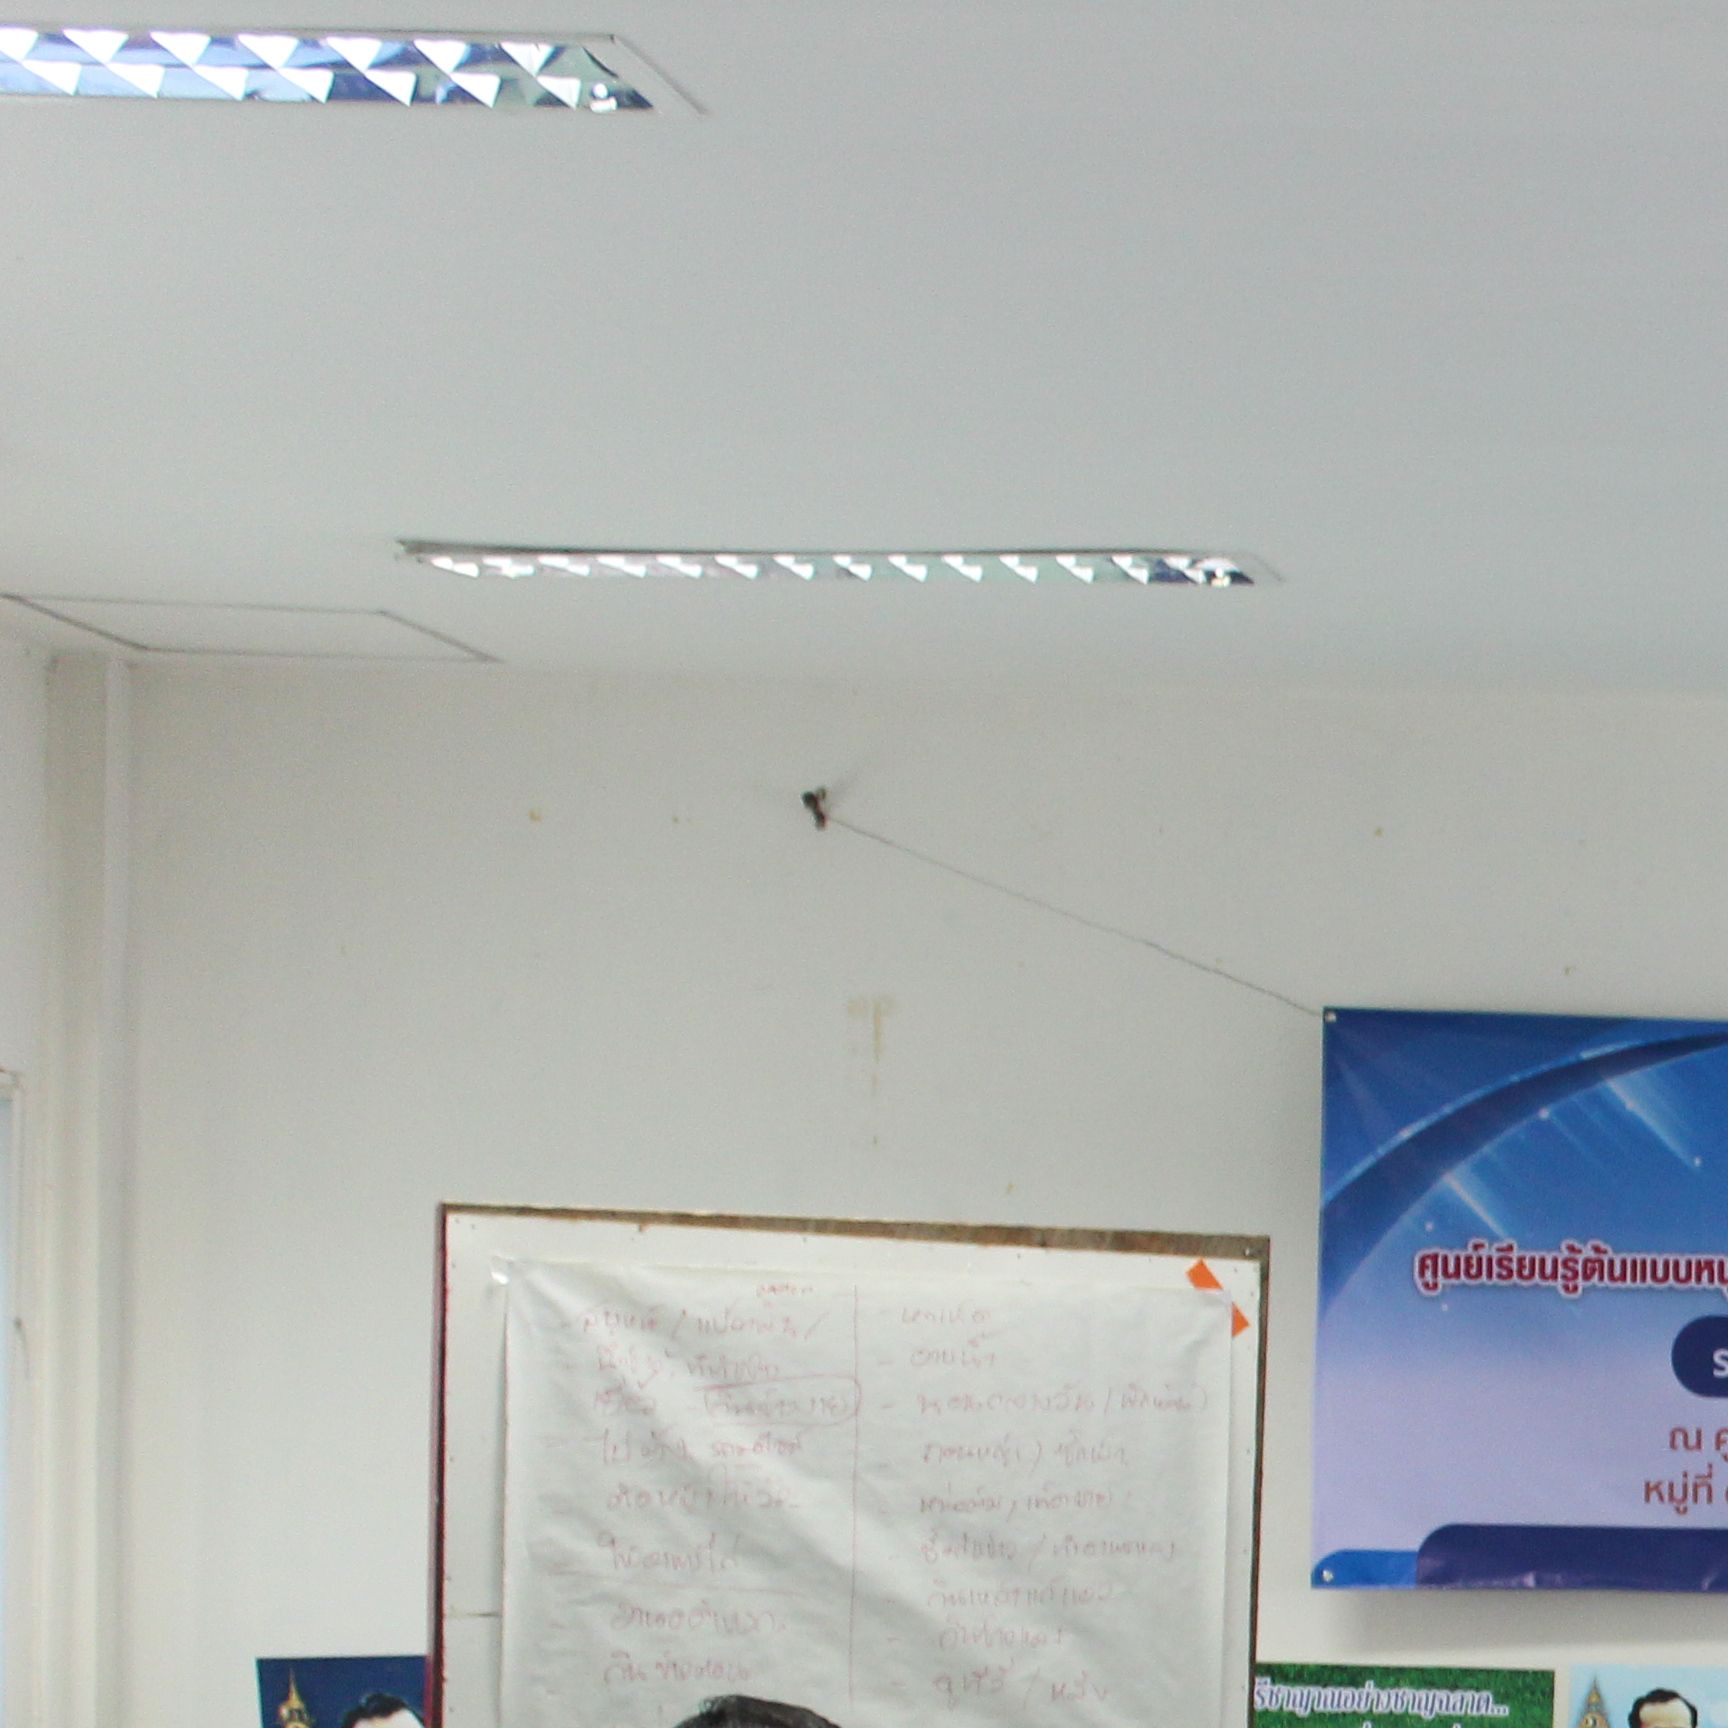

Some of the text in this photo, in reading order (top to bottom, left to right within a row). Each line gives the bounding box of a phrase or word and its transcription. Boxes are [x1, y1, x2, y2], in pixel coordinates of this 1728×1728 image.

[1668, 1424, 1703, 1453] ณ
[1643, 1463, 1714, 1517] หมู่ที่
